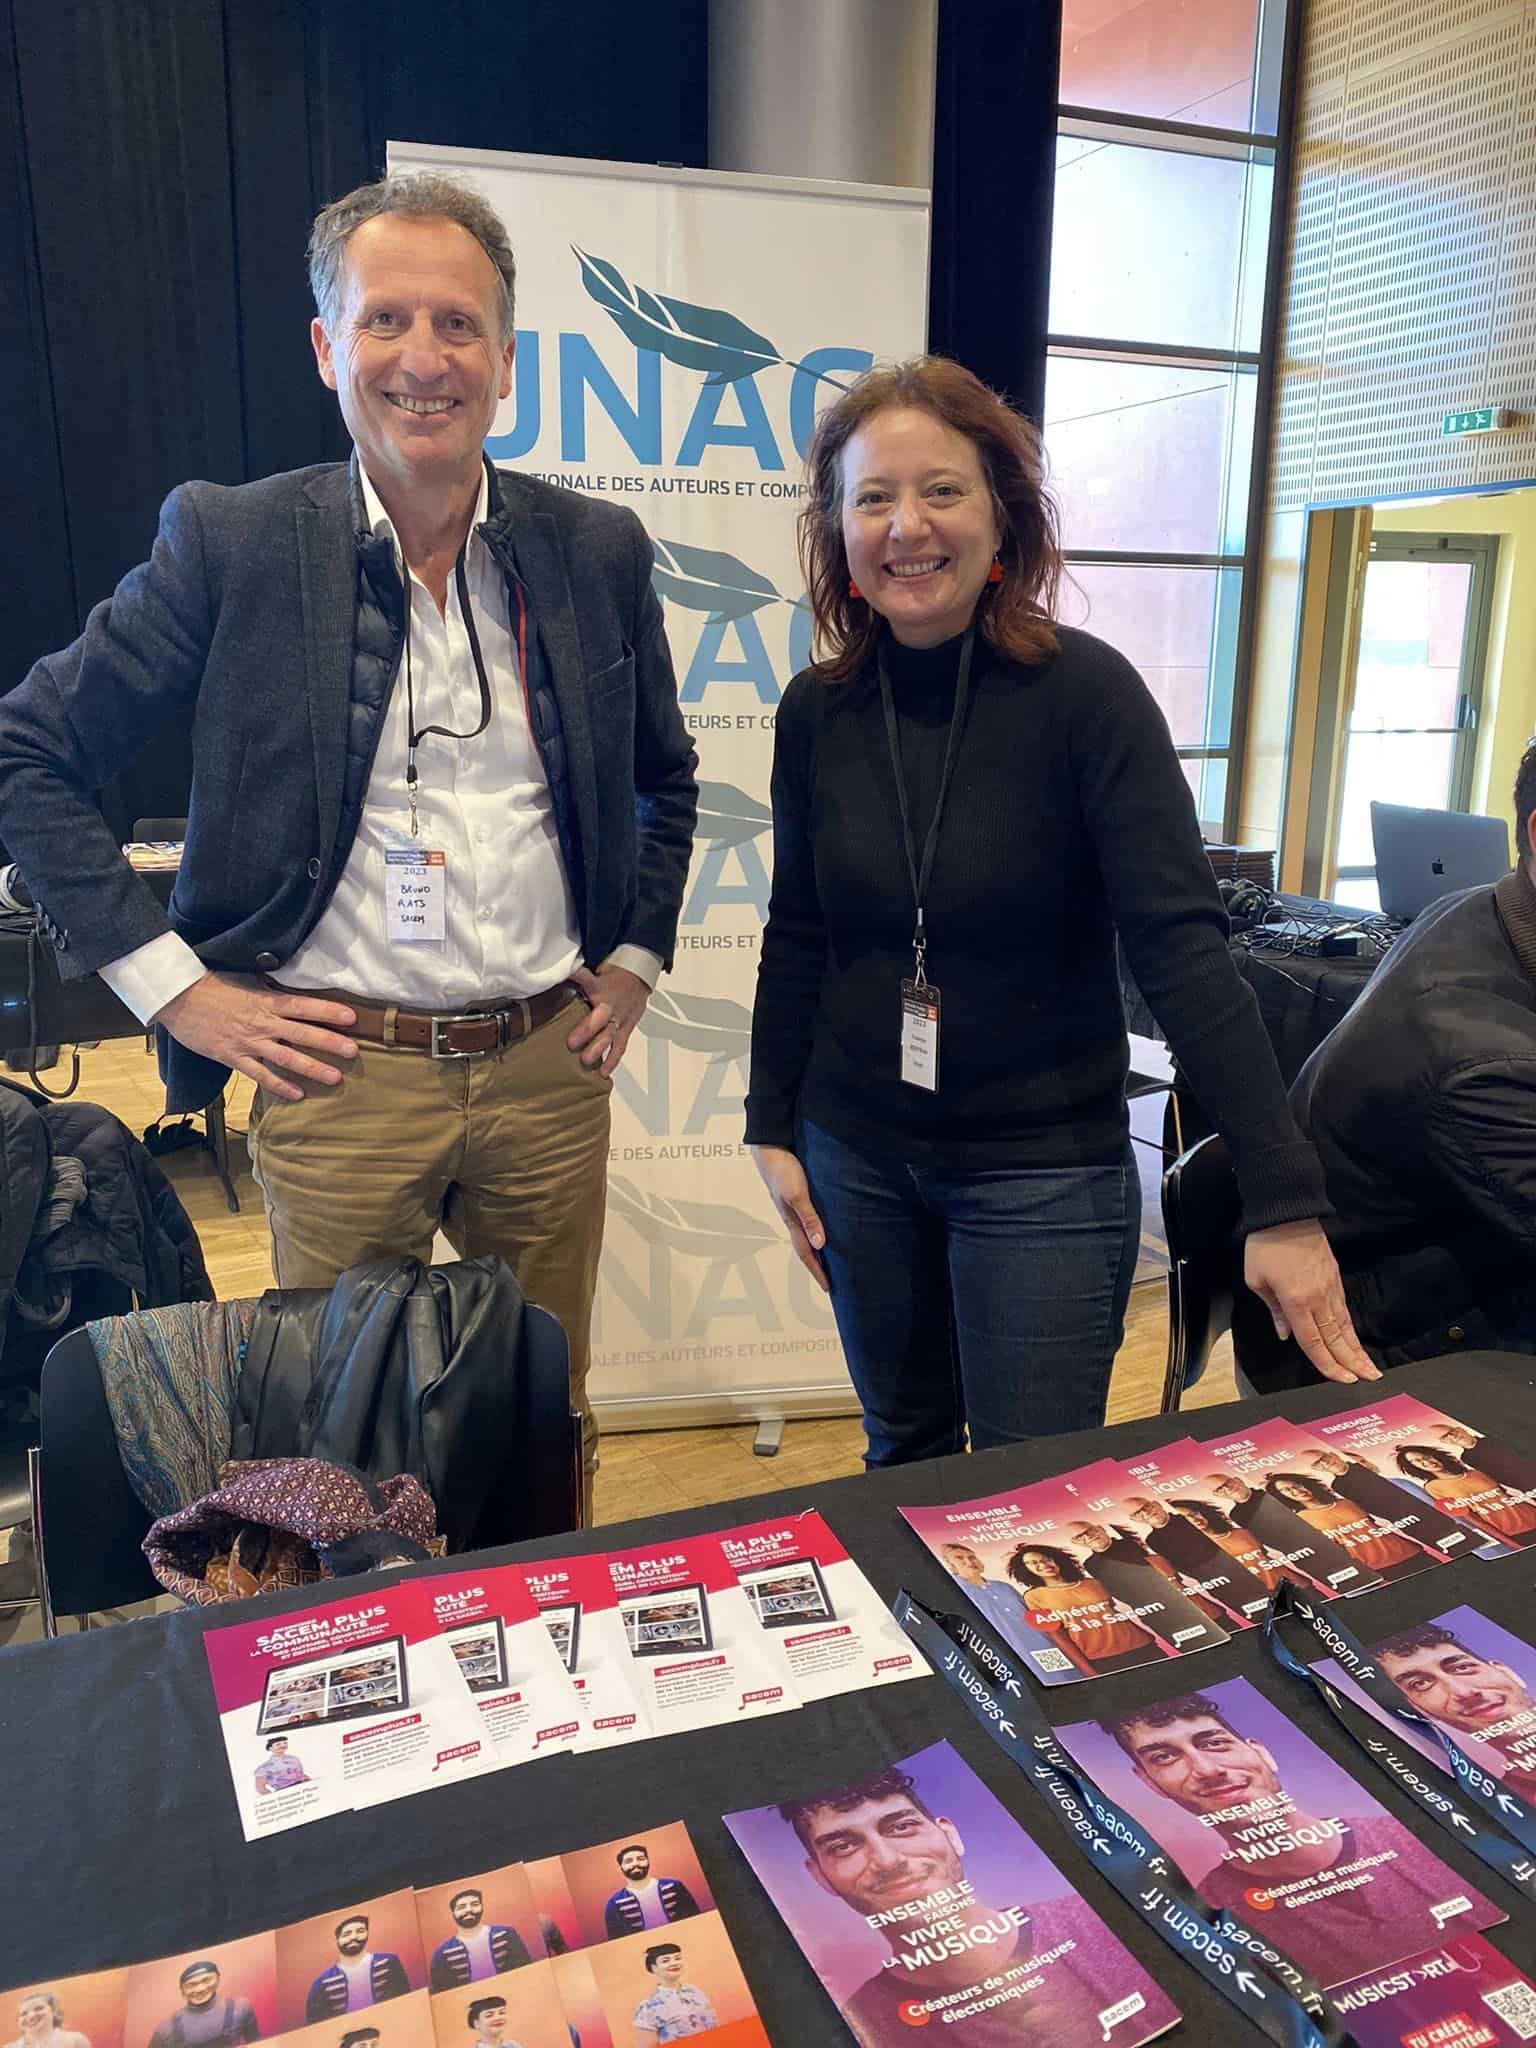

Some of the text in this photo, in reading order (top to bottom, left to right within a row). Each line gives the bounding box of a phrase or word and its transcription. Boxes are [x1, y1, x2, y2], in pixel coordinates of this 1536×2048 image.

[612, 477, 644, 492] DES
[649, 478, 730, 496] AUTEURS
[735, 482, 755, 497] ET
[736, 716, 755, 729] ET
[737, 936, 756, 948] ET
[624, 1147, 653, 1161] DES
[658, 1144, 733, 1159] AUTEURS
[626, 1350, 656, 1365] DES
[660, 1346, 733, 1362] AUTEURS
[738, 1343, 755, 1358] ET
[1322, 1413, 1383, 1434] ENSEMBLE
[1351, 1424, 1422, 1449] MUSIQUE
[945, 1504, 1022, 1523] ENSEMBLE
[1371, 1514, 1421, 1538] Sacem
[749, 1531, 794, 1546] PLUS
[968, 1520, 1058, 1543] MUSIQUE
[970, 1520, 1016, 1533] VIVRE
[639, 1555, 687, 1569] PLUS
[1259, 1547, 1316, 1571] Sacem
[433, 1587, 485, 1607] PLUS
[1034, 1601, 1109, 1625] Adhérer
[1081, 1617, 1103, 1630] la
[1101, 1601, 1166, 1625] Sacem
[256, 1620, 330, 1647] SACEM
[333, 1605, 387, 1626] PLUS
[957, 1622, 1013, 1682] sacem.fr
[1312, 1616, 1376, 1681] sacem.fr
[876, 1656, 911, 1669] sacem
[744, 1688, 781, 1701] sacem
[944, 1650, 1004, 1720] sacem.fr
[539, 1723, 577, 1739] sacem
[595, 1715, 634, 1728] sacem
[439, 1743, 479, 1761] sacem
[1366, 1738, 1453, 1813] sacem.fr
[1034, 1764, 1100, 1840] sacem.fr
[1199, 1791, 1294, 1827] ENSEMBLE
[1251, 1804, 1297, 1825] FAISONS
[1220, 1816, 1350, 1864] LA MUSIQUE
[1233, 1818, 1291, 1843] VIVRE
[1252, 1848, 1399, 1903] Créateurs de musiques
[1284, 1873, 1375, 1909] électroniques
[865, 1879, 975, 1929] ENSEMBLE
[923, 1896, 976, 1924] FAISONS
[881, 1905, 1031, 1972] LA MUSIQUE
[900, 1915, 966, 1946] VIVRE
[1139, 1887, 1236, 1975] sacem.fr
[907, 1939, 1078, 2018] Créateurs de musiques
[1220, 1921, 1325, 2017] sacem.fr
[941, 1974, 1046, 2025] électroniques
[1103, 1995, 1143, 2024] sacem
